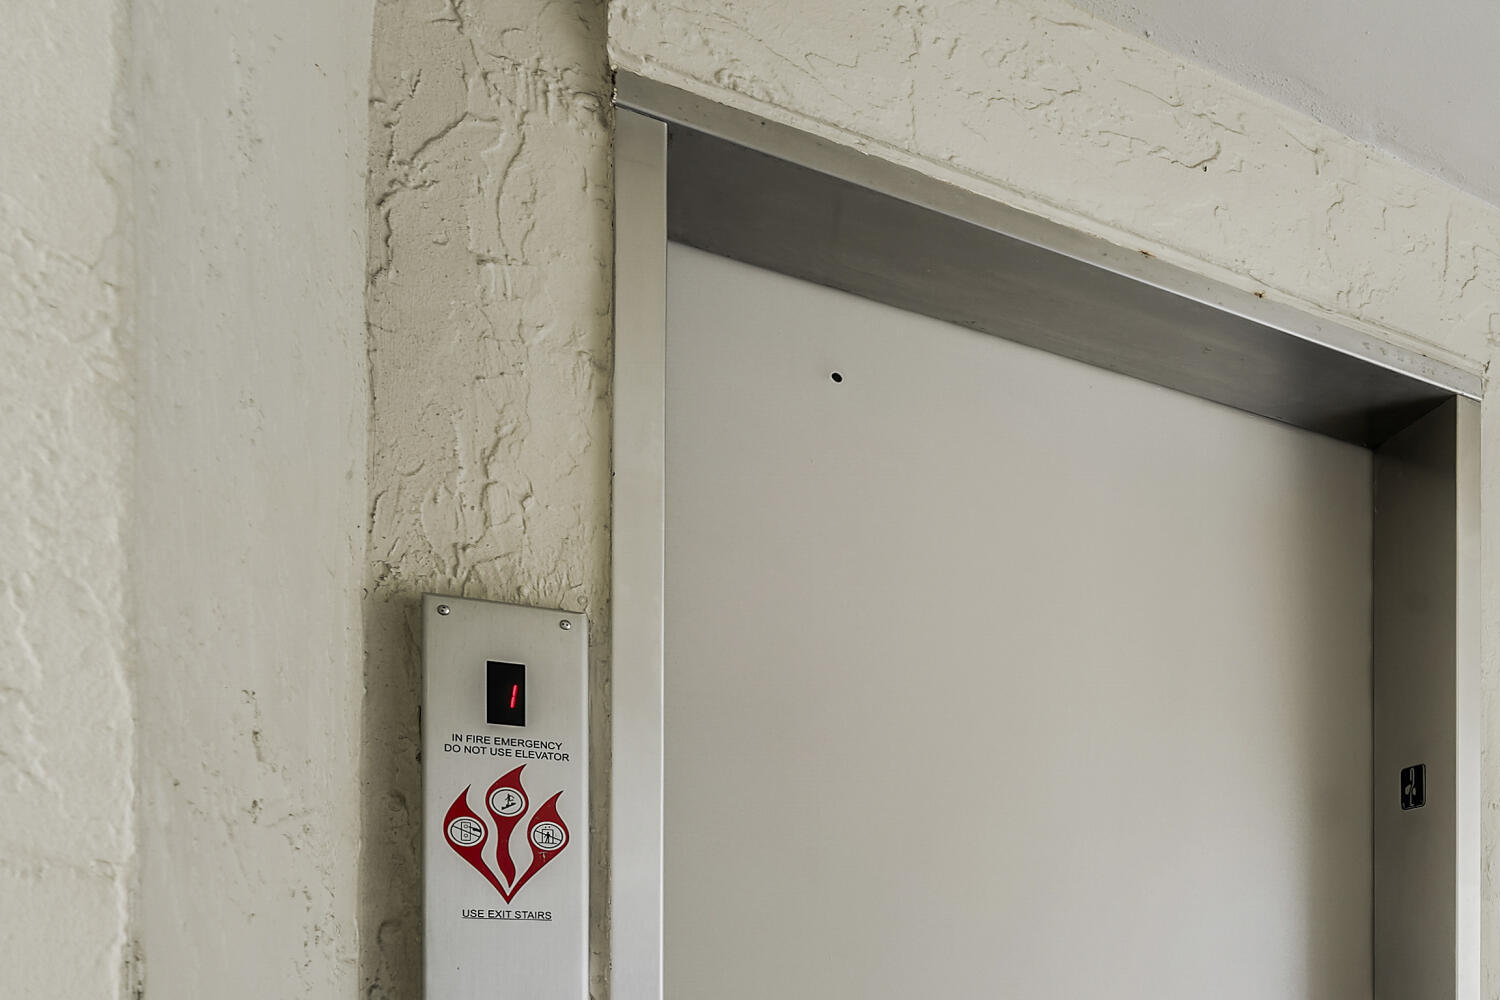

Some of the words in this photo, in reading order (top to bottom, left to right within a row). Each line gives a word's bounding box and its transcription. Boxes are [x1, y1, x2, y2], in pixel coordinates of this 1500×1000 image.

[510, 684, 518, 709] 1
[452, 733, 463, 743] IN
[466, 734, 491, 745] FIRE
[494, 737, 563, 751] EMERGENCY
[444, 743, 461, 752] DO
[464, 745, 487, 755] NOT
[490, 747, 512, 757] USE
[515, 750, 570, 762] ELEVATOR
[462, 909, 485, 918] USE
[487, 909, 512, 919] EXIT
[514, 910, 552, 920] STAIRS
